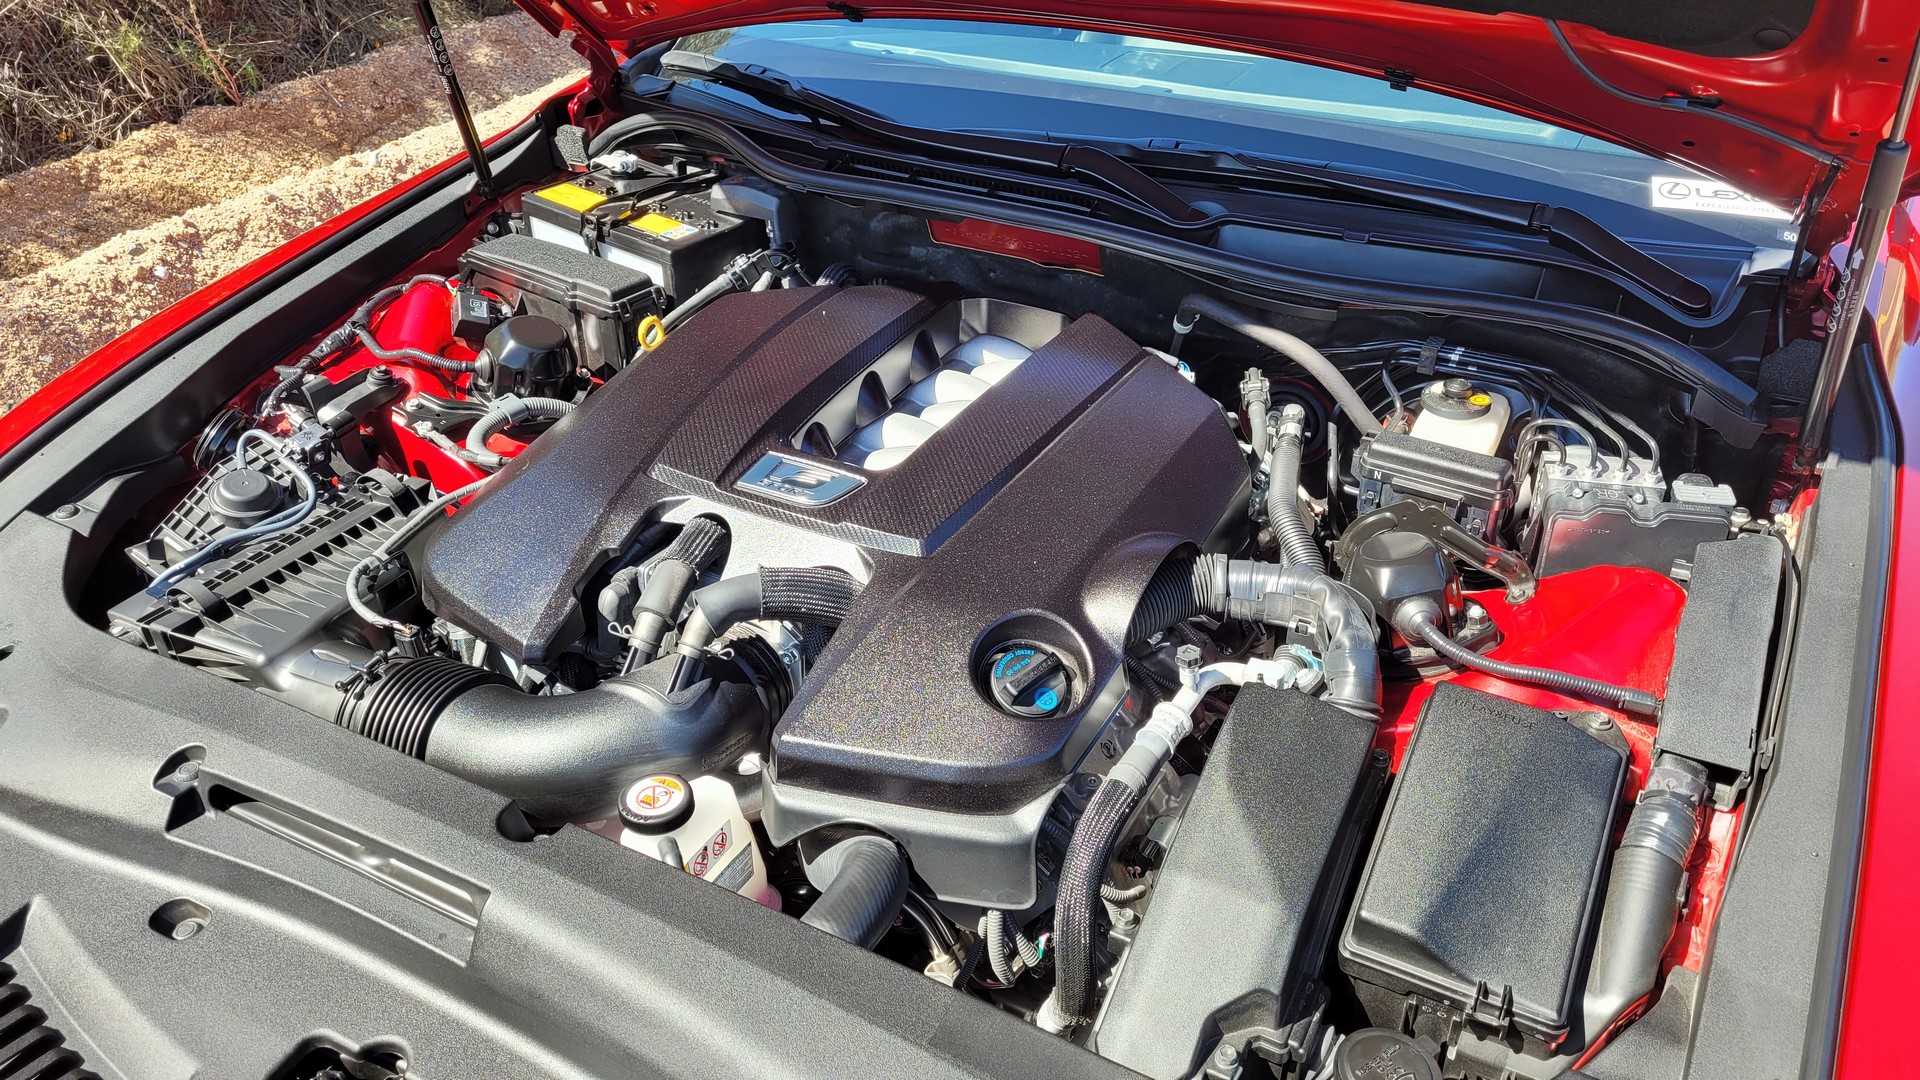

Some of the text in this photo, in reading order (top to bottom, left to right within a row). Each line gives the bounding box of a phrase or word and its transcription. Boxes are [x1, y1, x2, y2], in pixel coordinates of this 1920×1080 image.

[1695, 187, 1761, 202] LEX
[1696, 202, 1748, 211] EXPERIENCE
[756, 478, 815, 495] SPORT
